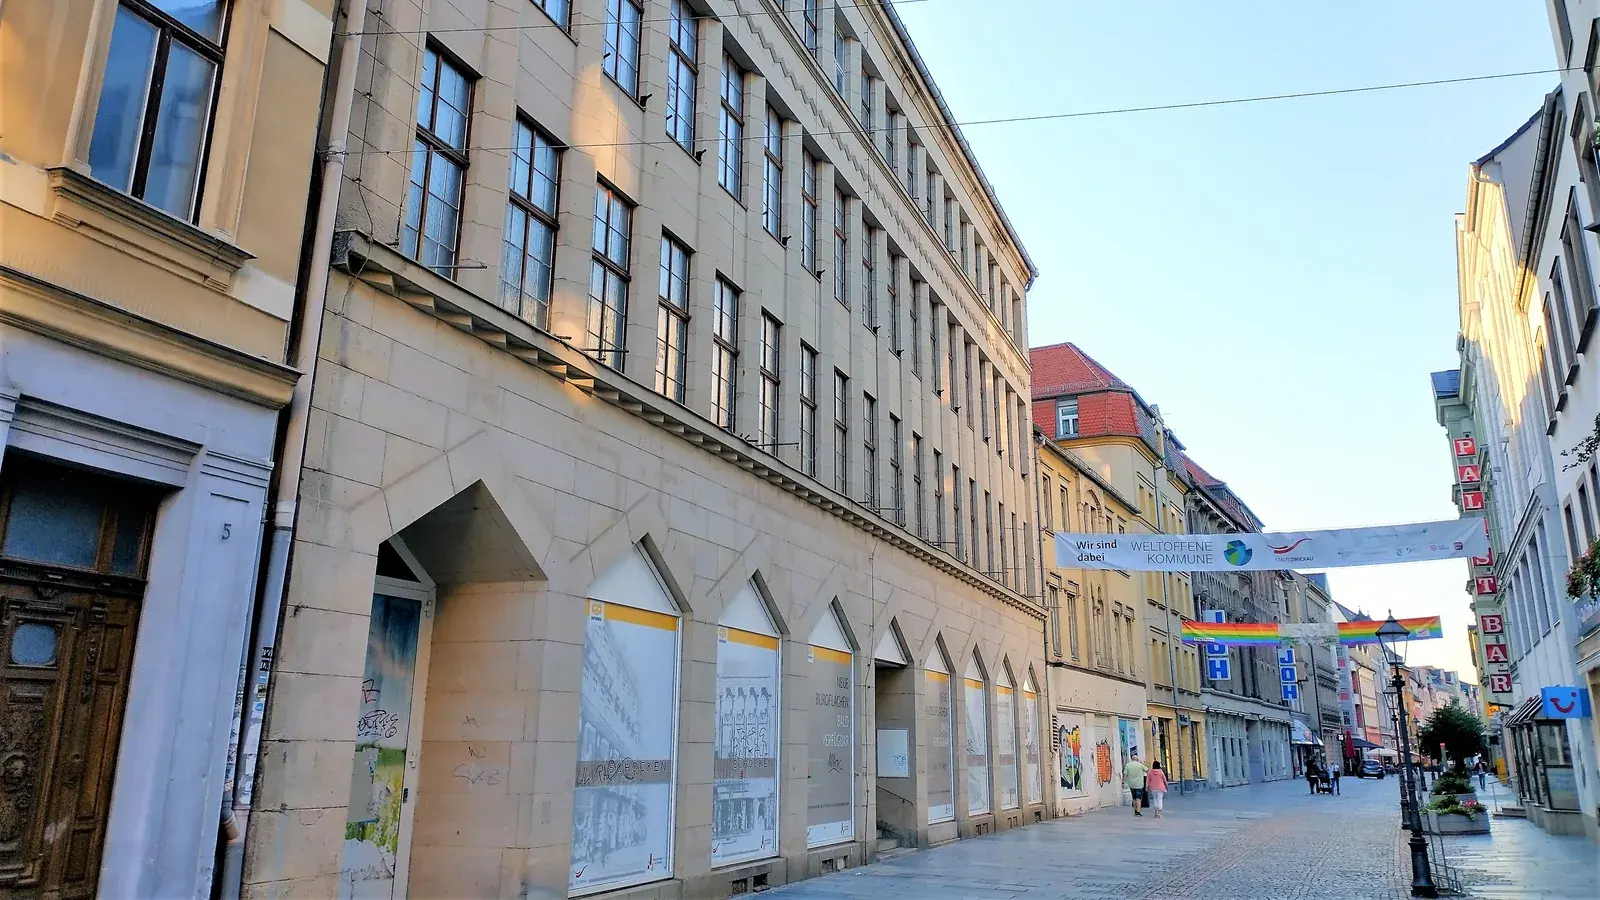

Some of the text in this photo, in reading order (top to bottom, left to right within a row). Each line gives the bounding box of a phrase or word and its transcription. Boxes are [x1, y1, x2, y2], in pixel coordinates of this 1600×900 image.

[221, 523, 232, 540] 5
[1076, 539, 1118, 550] Wir sind
[1130, 541, 1213, 552] WELTOFFENE
[1077, 552, 1105, 562] dabei
[1147, 553, 1213, 565] KOMMUNE
[1456, 439, 1512, 692] PALST BAR
[1280, 649, 1299, 700] JOH
[836, 677, 849, 690] NEUE
[608, 760, 667, 773] SCHOCKEN
